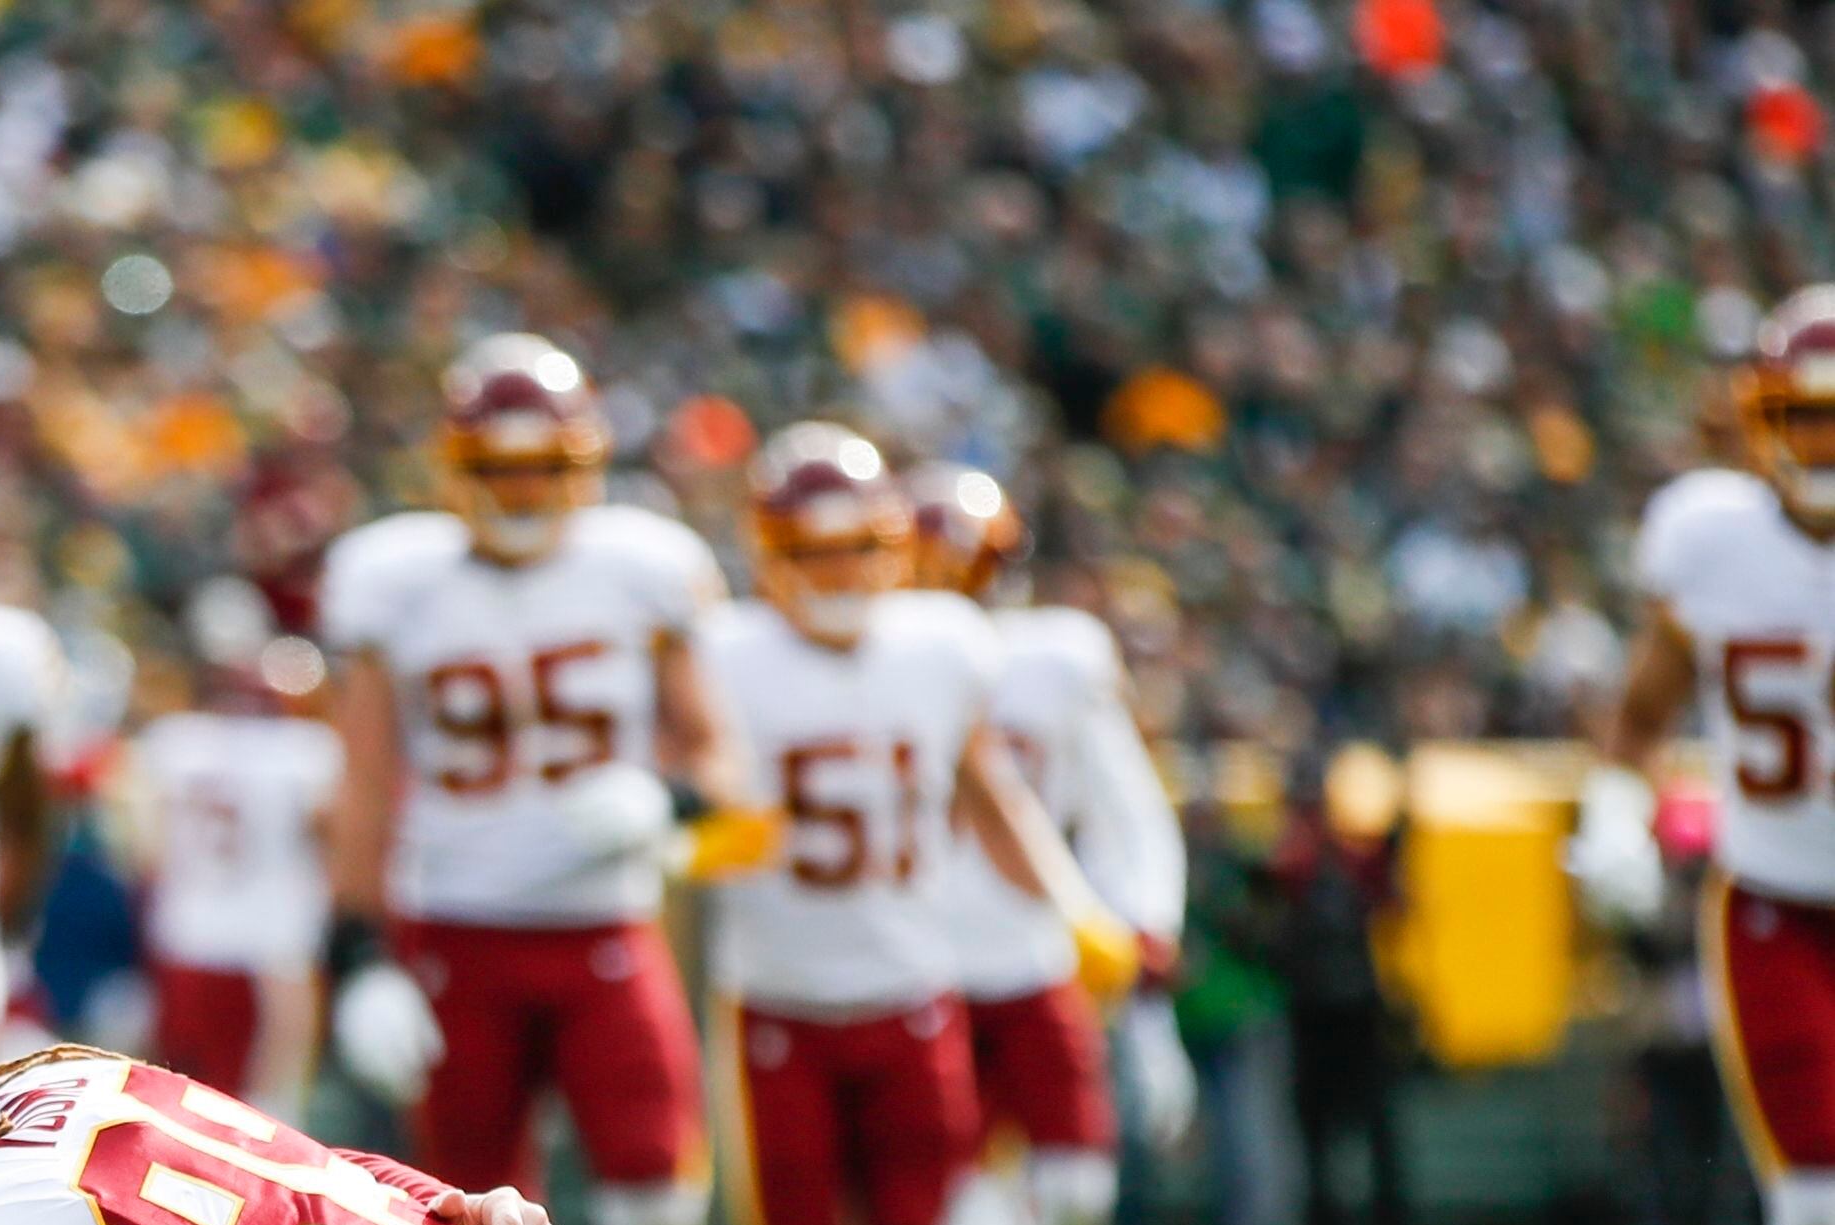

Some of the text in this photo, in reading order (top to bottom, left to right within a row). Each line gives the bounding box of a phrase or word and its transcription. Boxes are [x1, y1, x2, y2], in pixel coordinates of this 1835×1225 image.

[427, 638, 614, 797] 95
[1722, 638, 1835, 803] 5
[780, 740, 917, 891] 51
